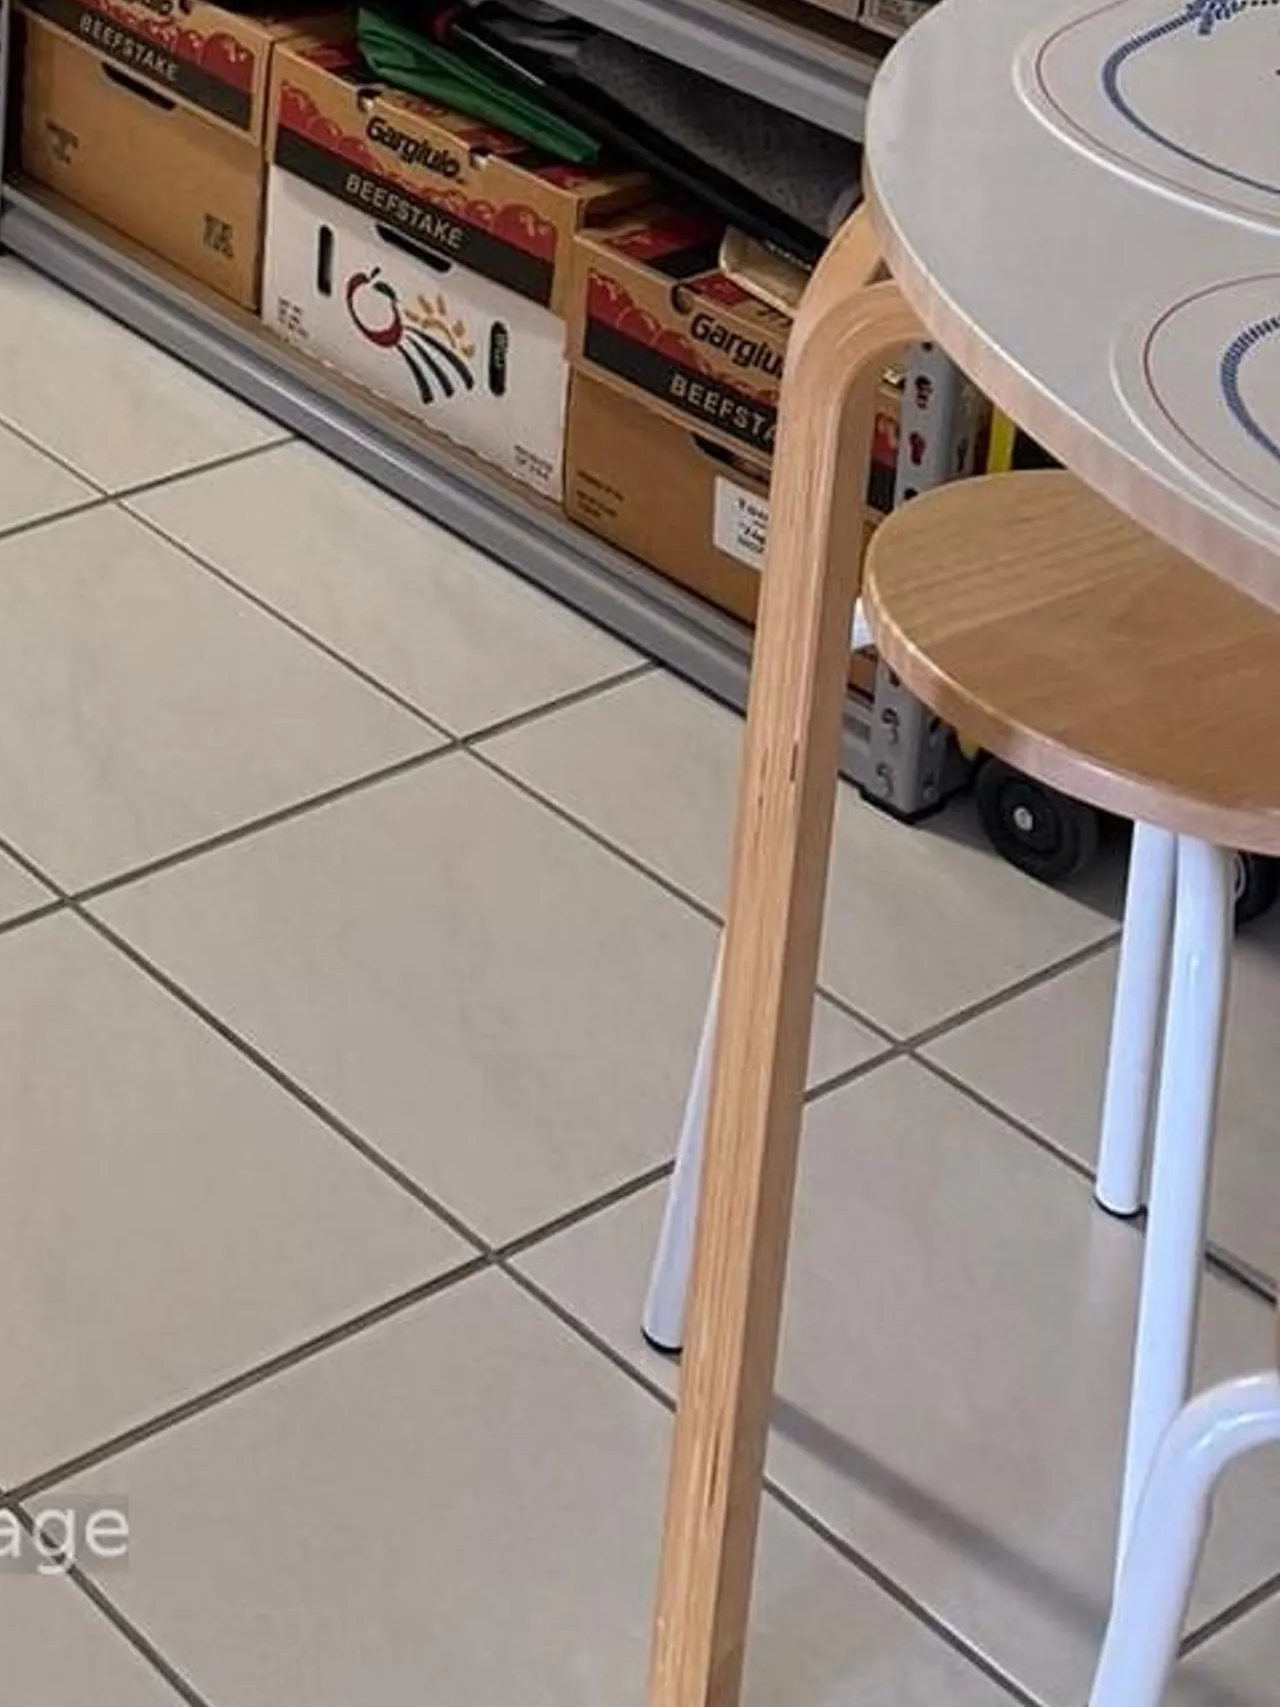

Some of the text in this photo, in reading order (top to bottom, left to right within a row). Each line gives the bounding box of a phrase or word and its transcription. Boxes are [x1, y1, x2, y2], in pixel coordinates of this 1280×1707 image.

[79, 11, 180, 82] BEEFSTAKE
[366, 116, 461, 179] Gargiulo
[345, 172, 464, 251] BEEFSTAKE
